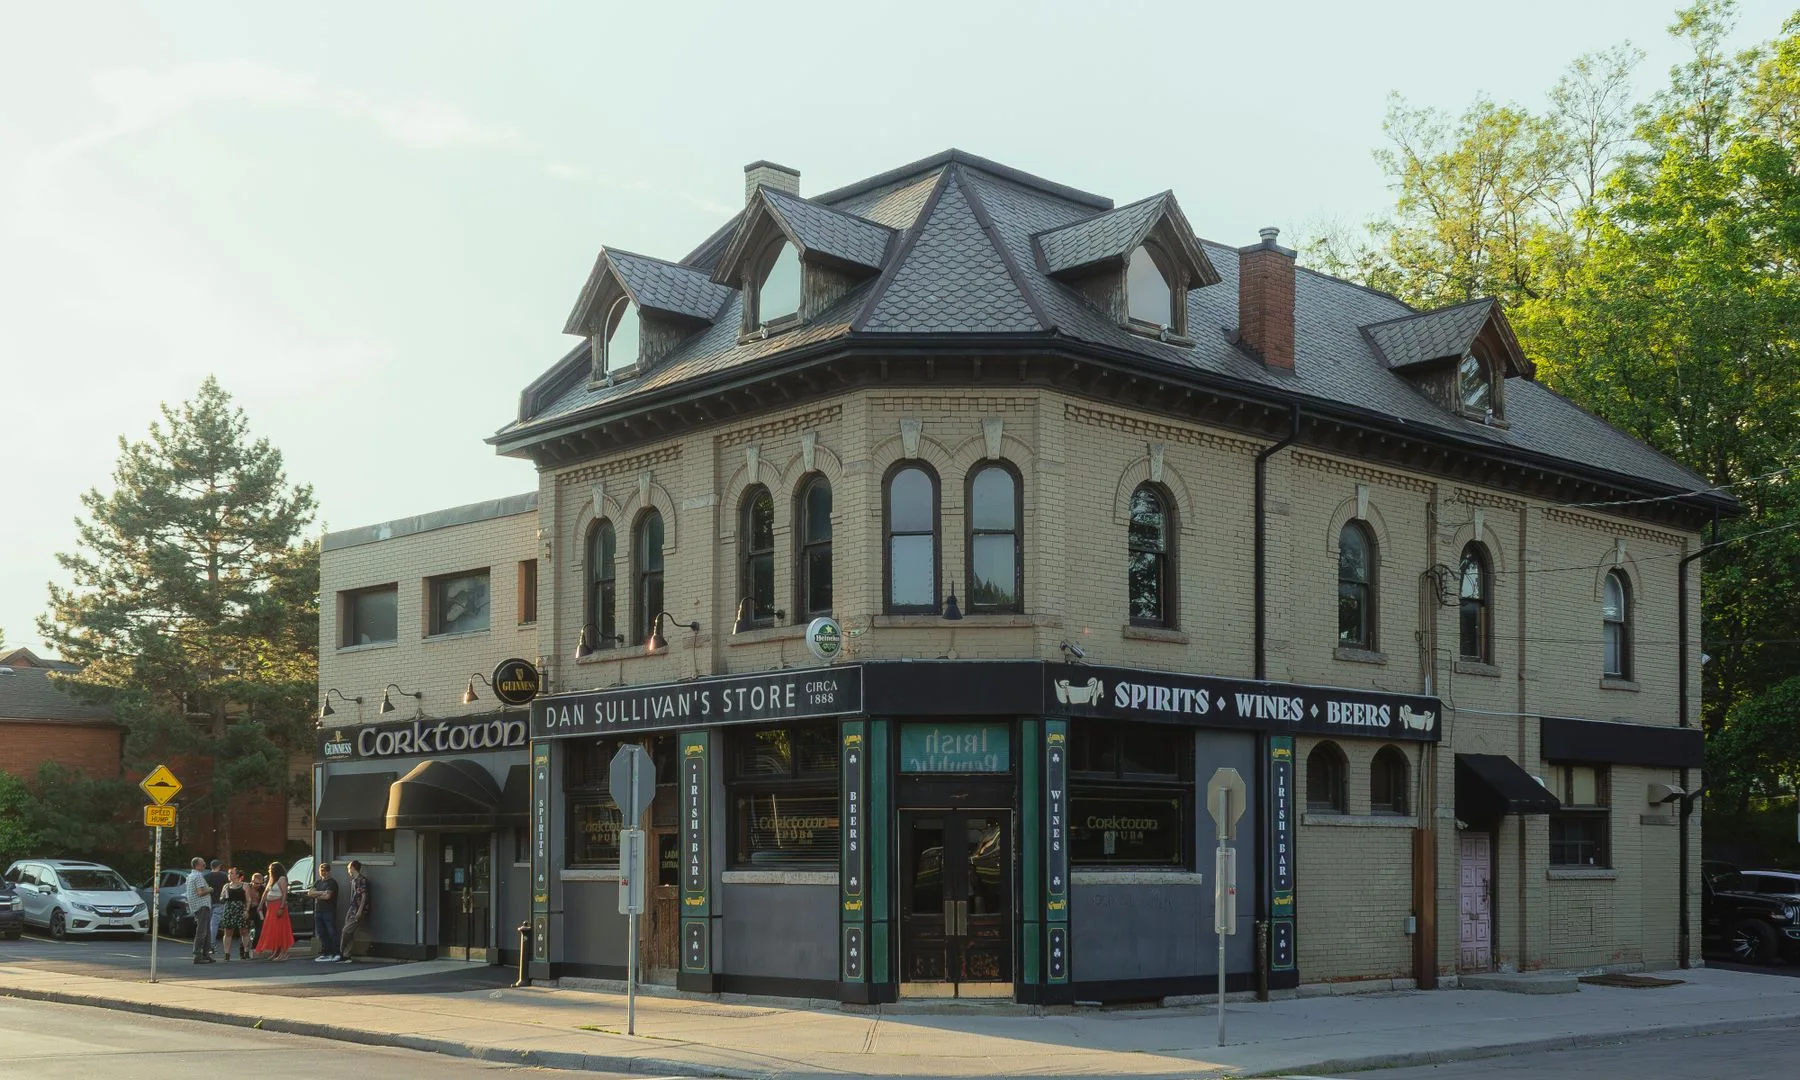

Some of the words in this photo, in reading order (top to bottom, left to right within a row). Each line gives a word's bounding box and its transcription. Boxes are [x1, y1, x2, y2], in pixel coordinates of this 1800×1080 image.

[502, 680, 535, 691] GUINNESS
[805, 680, 838, 693] CIRCA
[809, 692, 834, 705] 1888
[546, 703, 584, 728] DAN
[595, 690, 710, 724] SULLIVAN'S
[723, 683, 795, 713] STORE
[1114, 681, 1210, 715] SPIRITS
[1235, 693, 1304, 722] WINES
[1327, 700, 1391, 728] BEERS
[325, 742, 352, 755] GUINNESS
[357, 719, 528, 757] Corktown
[691, 773, 699, 830] IRISH
[1278, 775, 1286, 831] IRISH
[1051, 790, 1062, 851] WINES
[691, 842, 699, 876] BAR
[1279, 843, 1287, 876] BAR
